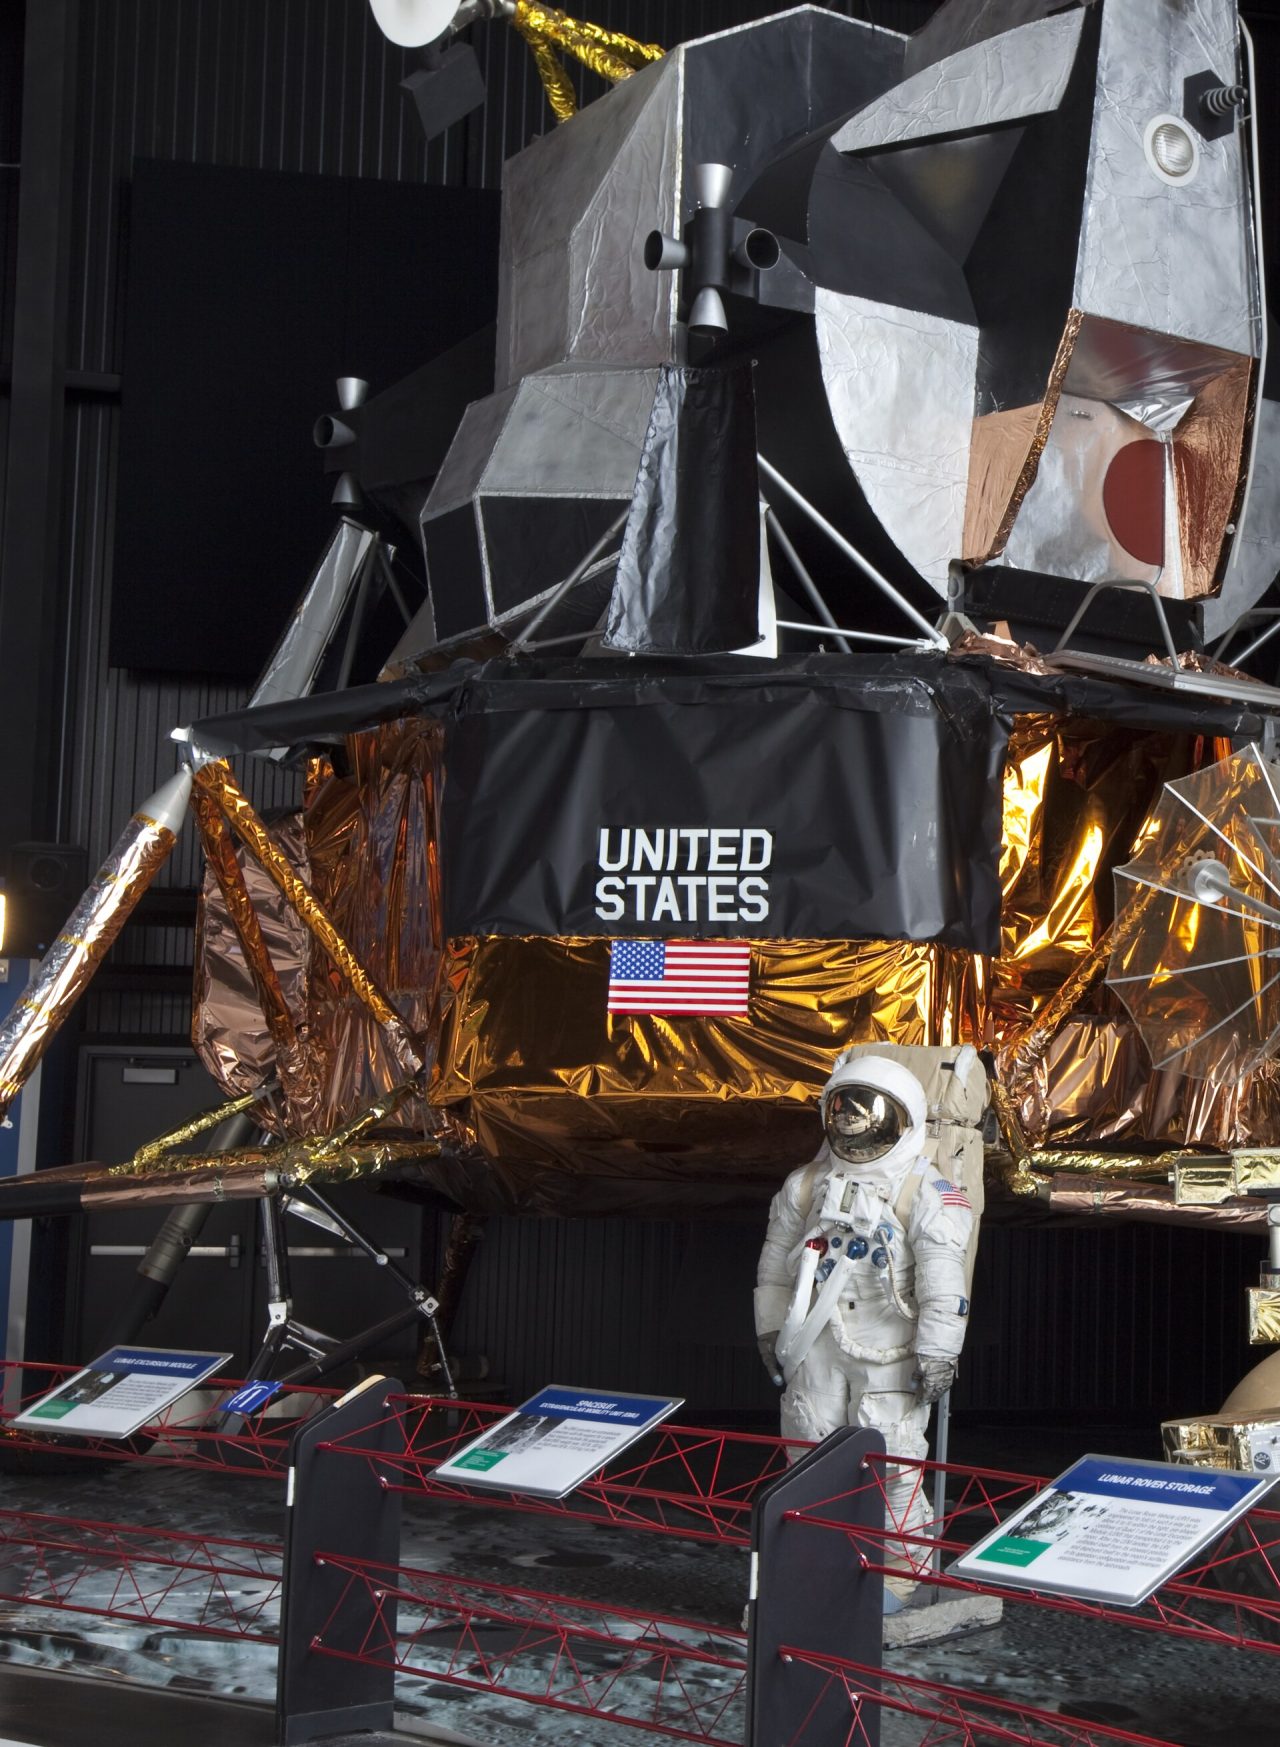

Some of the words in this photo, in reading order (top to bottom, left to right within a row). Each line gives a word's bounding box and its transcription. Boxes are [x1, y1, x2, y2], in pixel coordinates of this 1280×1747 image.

[598, 828, 773, 872] UNITED
[595, 876, 769, 921] STATES
[113, 1357, 136, 1365] LUNAR
[134, 1359, 170, 1367] EXCURSION
[576, 1400, 618, 1410] SPACESUIT
[583, 1408, 610, 1416] MOBILITY
[1098, 1474, 1135, 1485] LUNAR
[1131, 1477, 1167, 1489] ROVER
[1165, 1482, 1217, 1495] STORAGE
